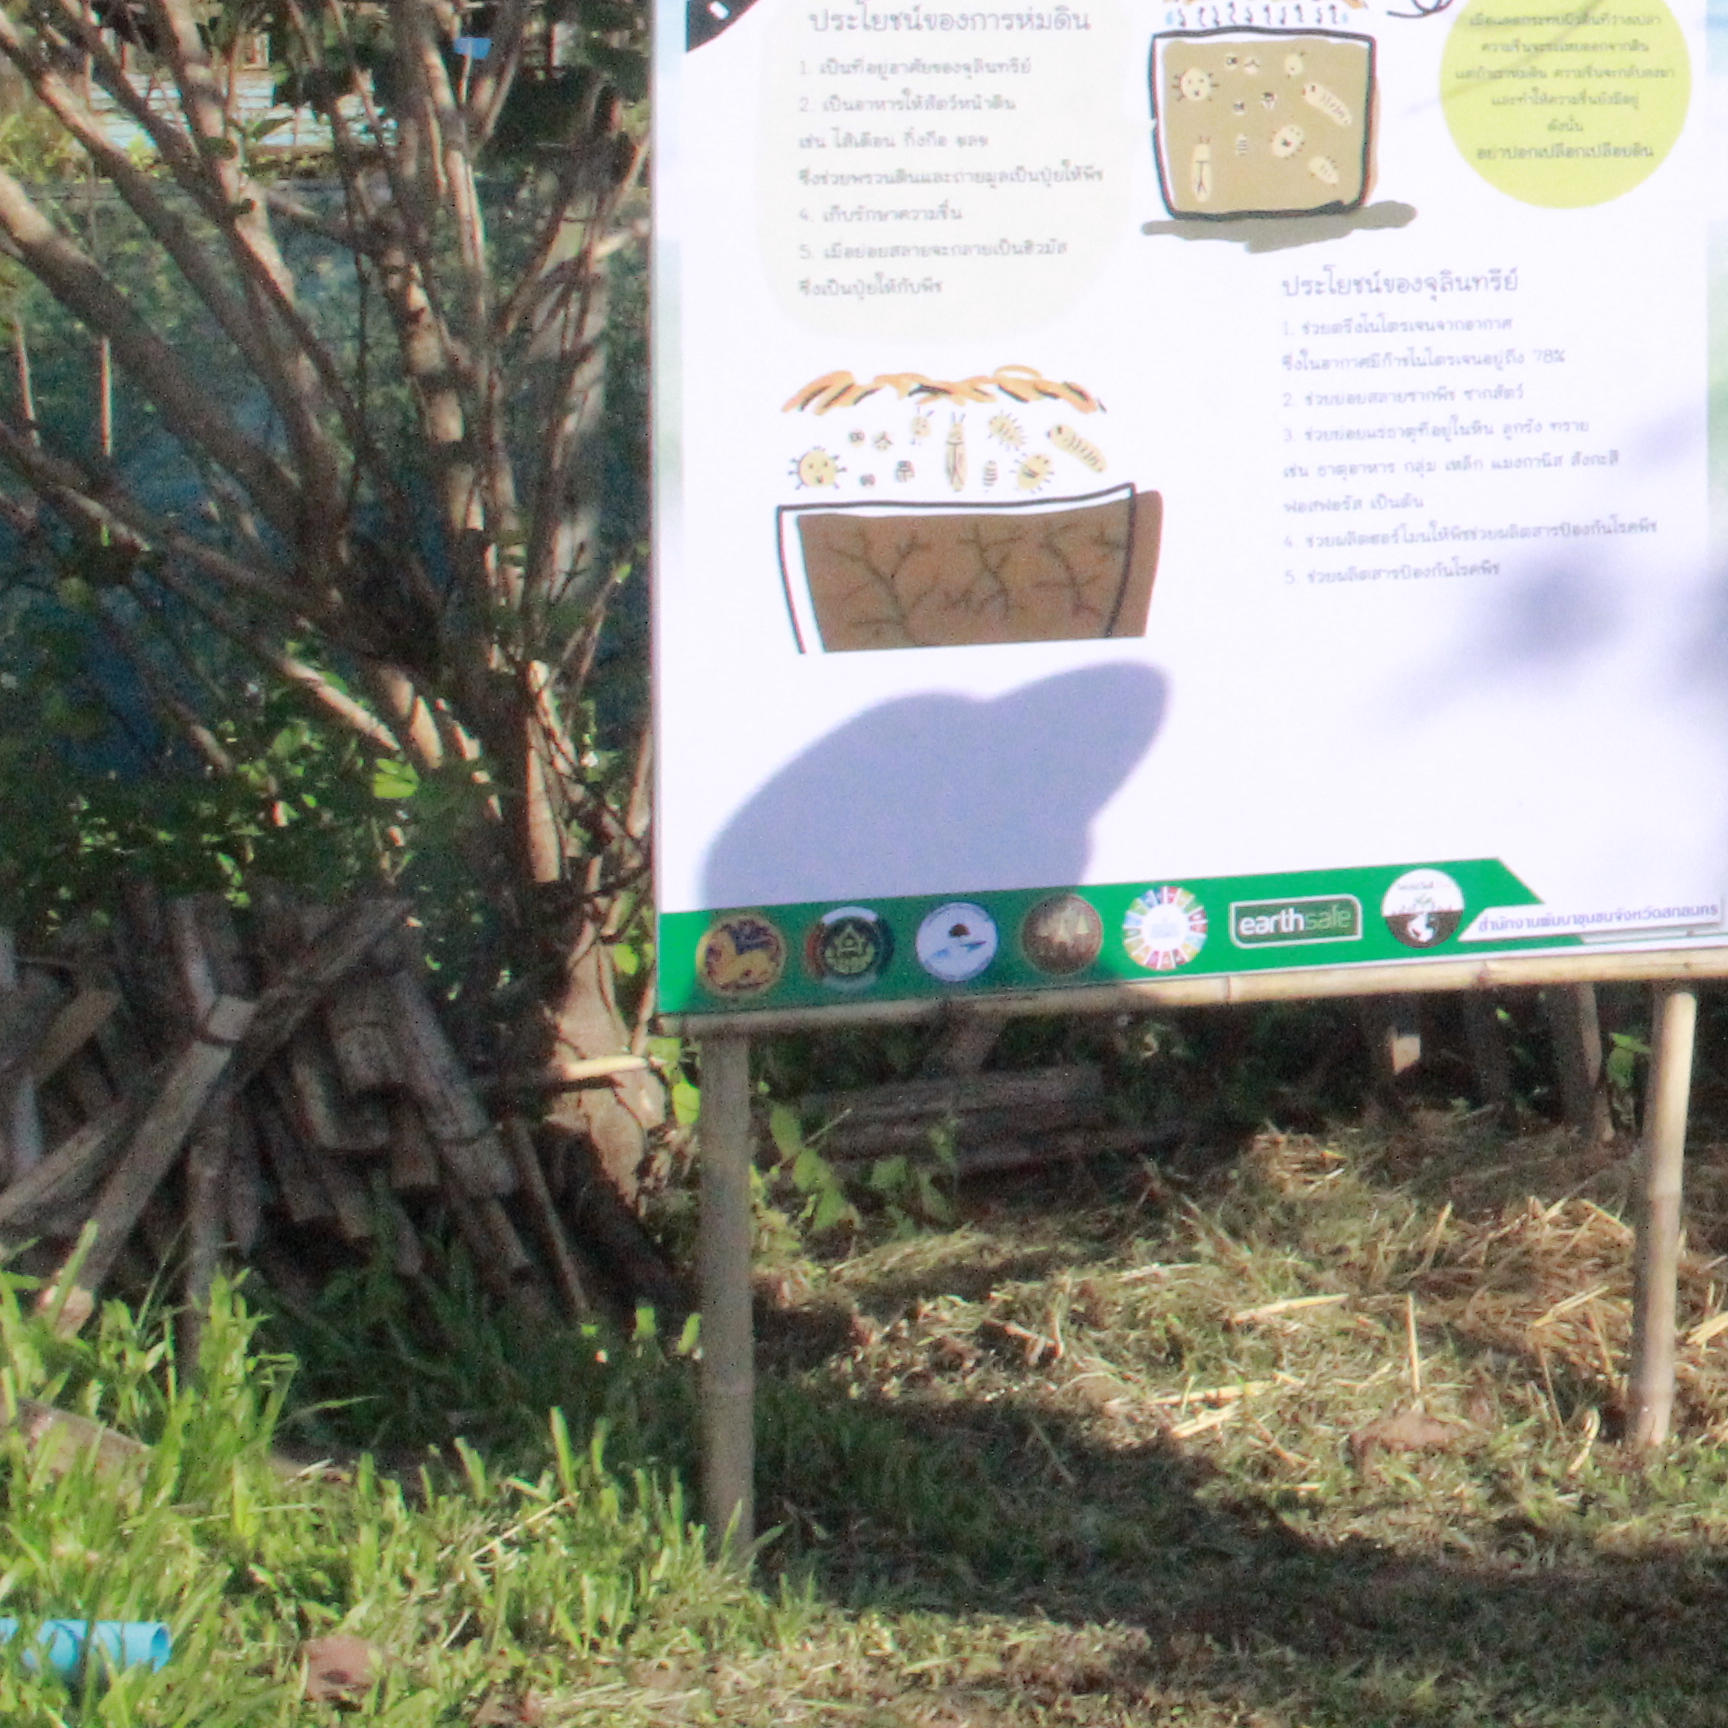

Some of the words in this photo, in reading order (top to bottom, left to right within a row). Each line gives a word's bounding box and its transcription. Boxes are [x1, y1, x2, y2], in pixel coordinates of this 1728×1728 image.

[1281, 264, 1519, 303] ประโยชน์ของจุลินทรีย์
[1533, 347, 1567, 365] 78%
